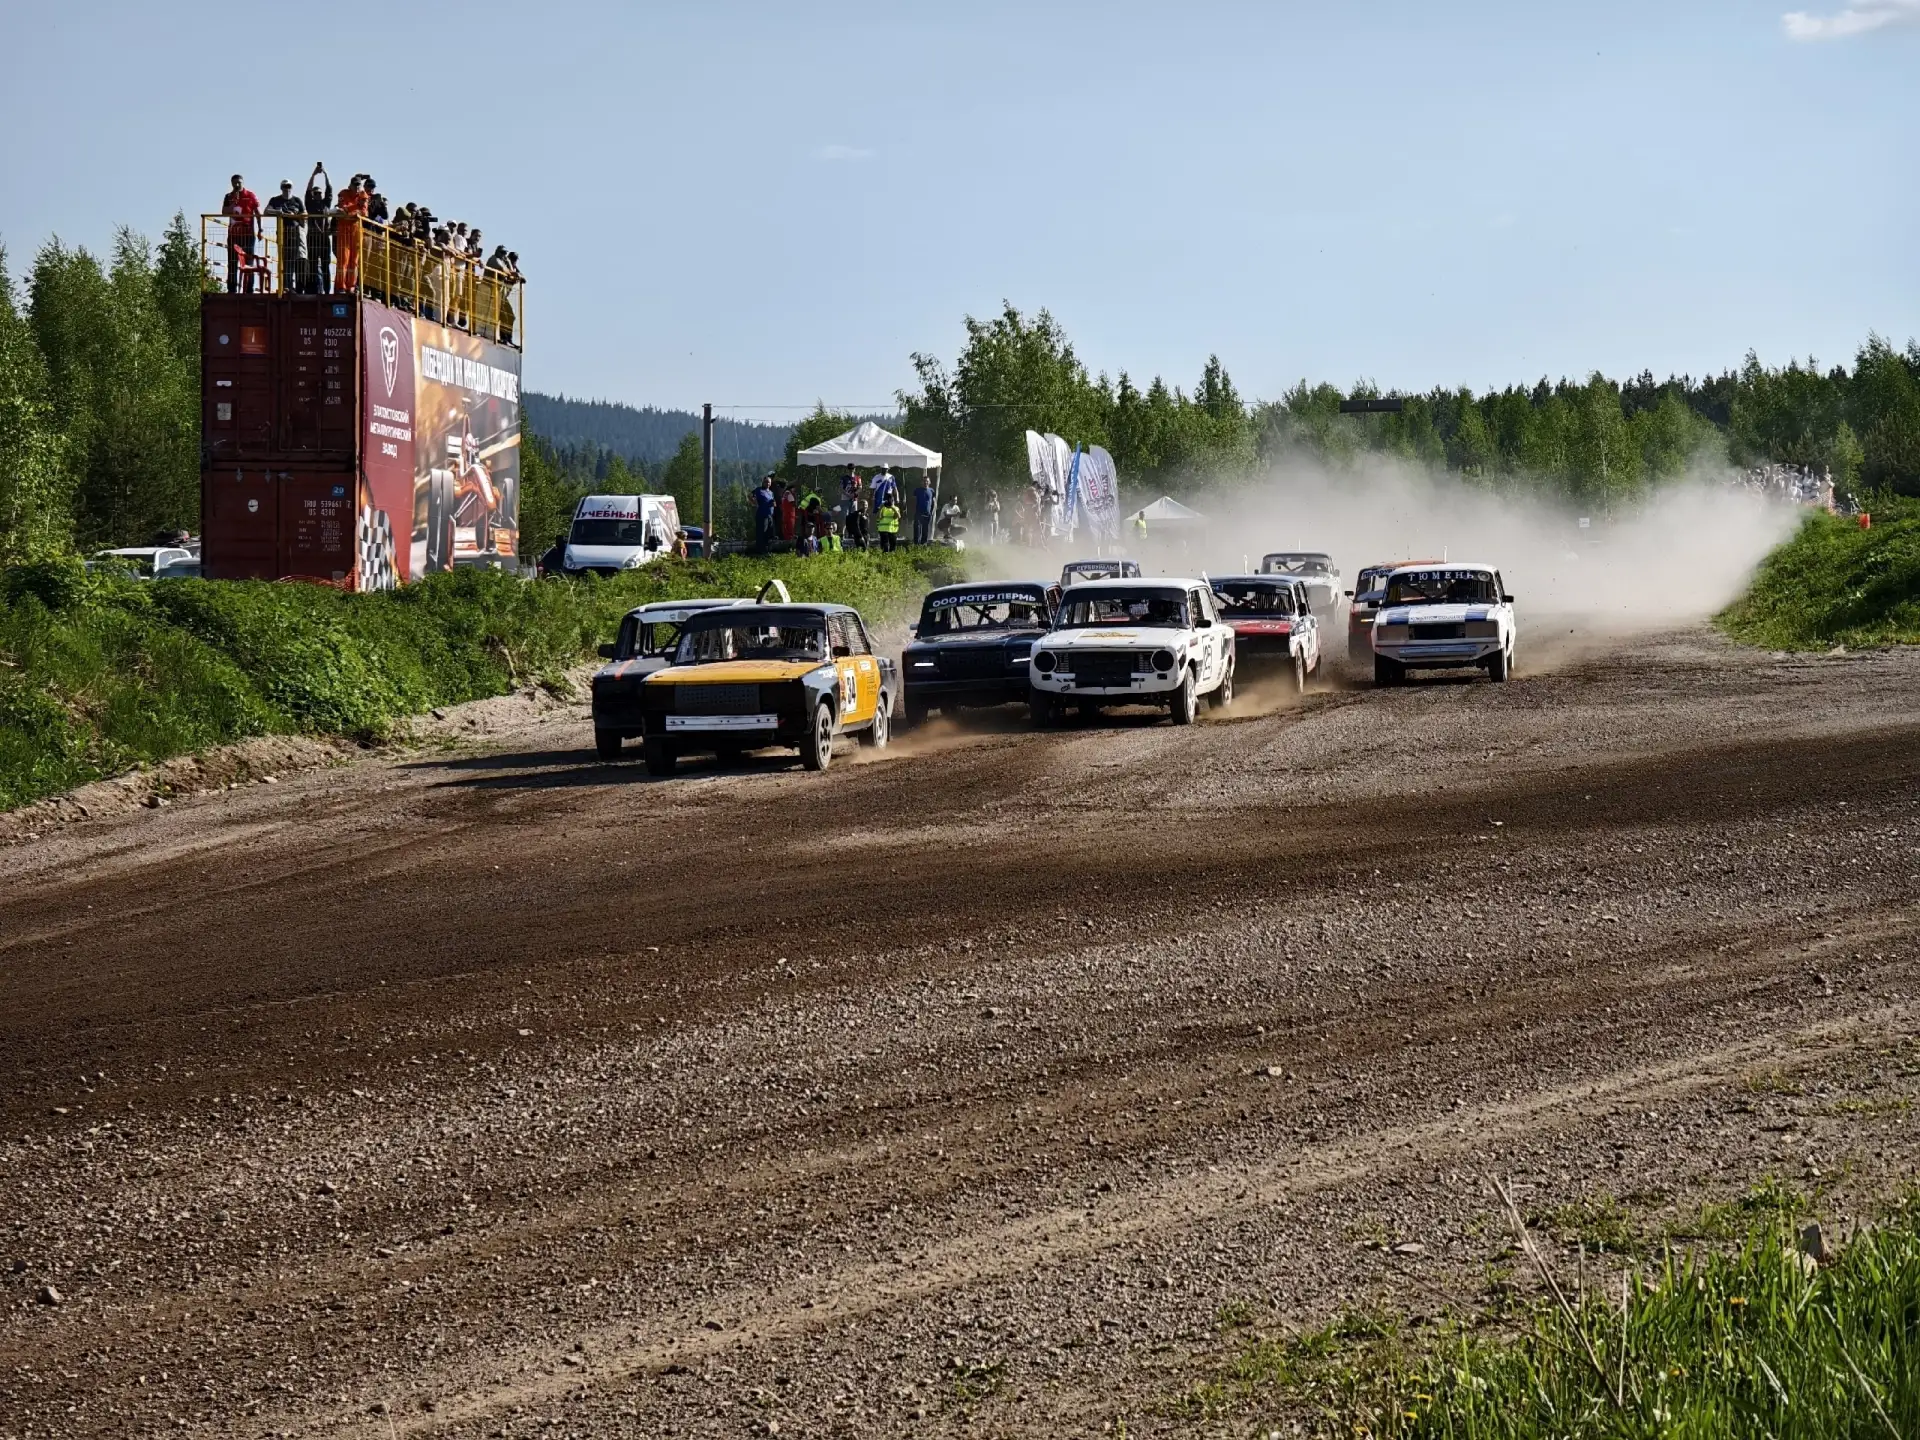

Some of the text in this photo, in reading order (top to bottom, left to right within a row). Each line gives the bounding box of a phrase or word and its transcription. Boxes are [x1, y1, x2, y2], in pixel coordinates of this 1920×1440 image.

[323, 338, 338, 346] 4310
[320, 508, 336, 516] 4310
[581, 510, 640, 519] УЧЕБНЫЙ
[1408, 571, 1473, 581] ТЮМЕНЬ
[932, 592, 1036, 607] ООО РОТЕР ПЕРМЬ
